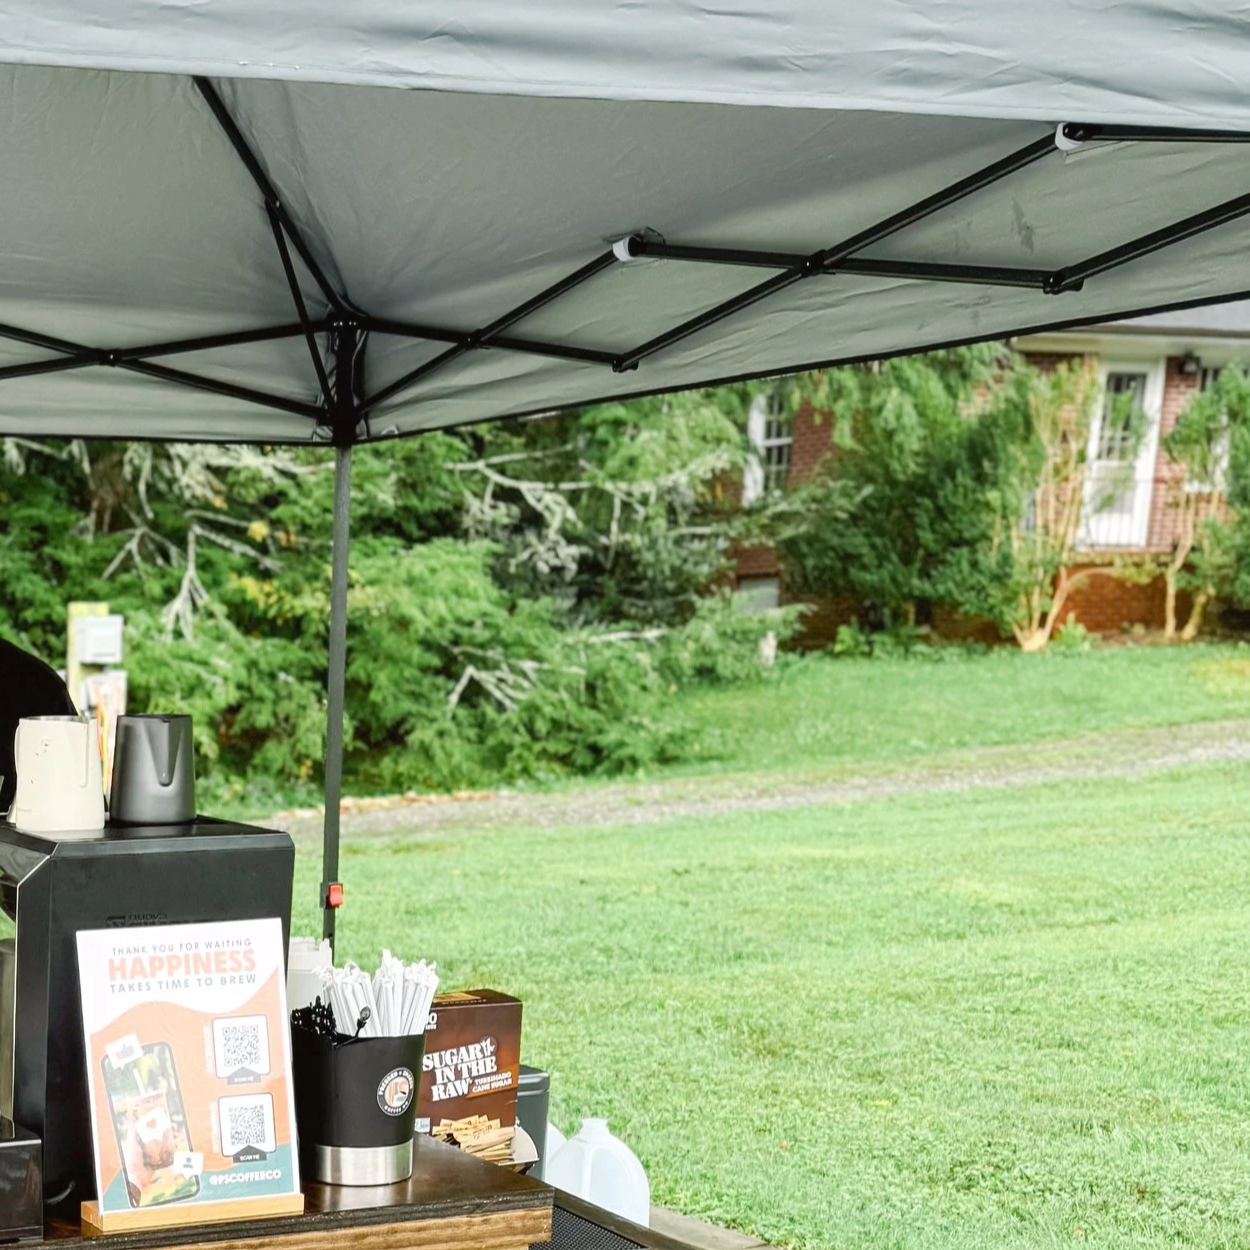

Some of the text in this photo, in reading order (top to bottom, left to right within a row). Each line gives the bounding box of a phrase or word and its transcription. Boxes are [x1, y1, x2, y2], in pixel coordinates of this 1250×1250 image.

[112, 938, 252, 956] THANK YOU FOR WAITING
[108, 948, 256, 981] HAPPINESS
[110, 973, 256, 994] TAKES TIME TO BREW
[422, 1043, 483, 1072] SUGAR
[435, 1056, 498, 1085] IN THE
[474, 1071, 512, 1086] TURBINADO
[431, 1078, 512, 1102] RAW CANE SUGAR
[209, 1169, 282, 1185] @PSCOFFEECO
